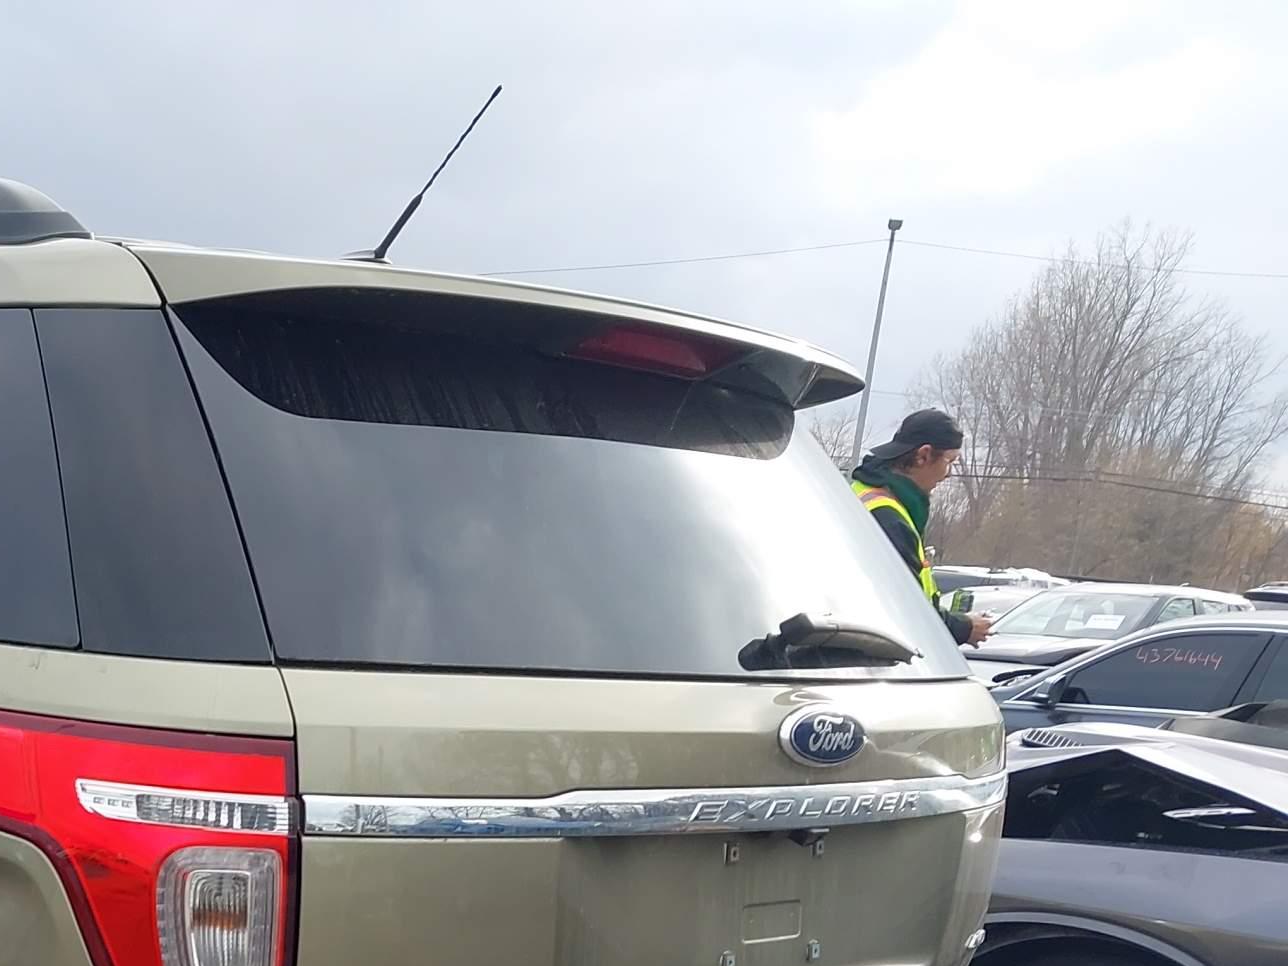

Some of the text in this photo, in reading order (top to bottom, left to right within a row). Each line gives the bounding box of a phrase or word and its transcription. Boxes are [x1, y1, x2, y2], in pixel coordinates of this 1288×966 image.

[1136, 647, 1223, 671] 43761644
[808, 714, 856, 752] Ford
[688, 790, 921, 823] EXPLORER
